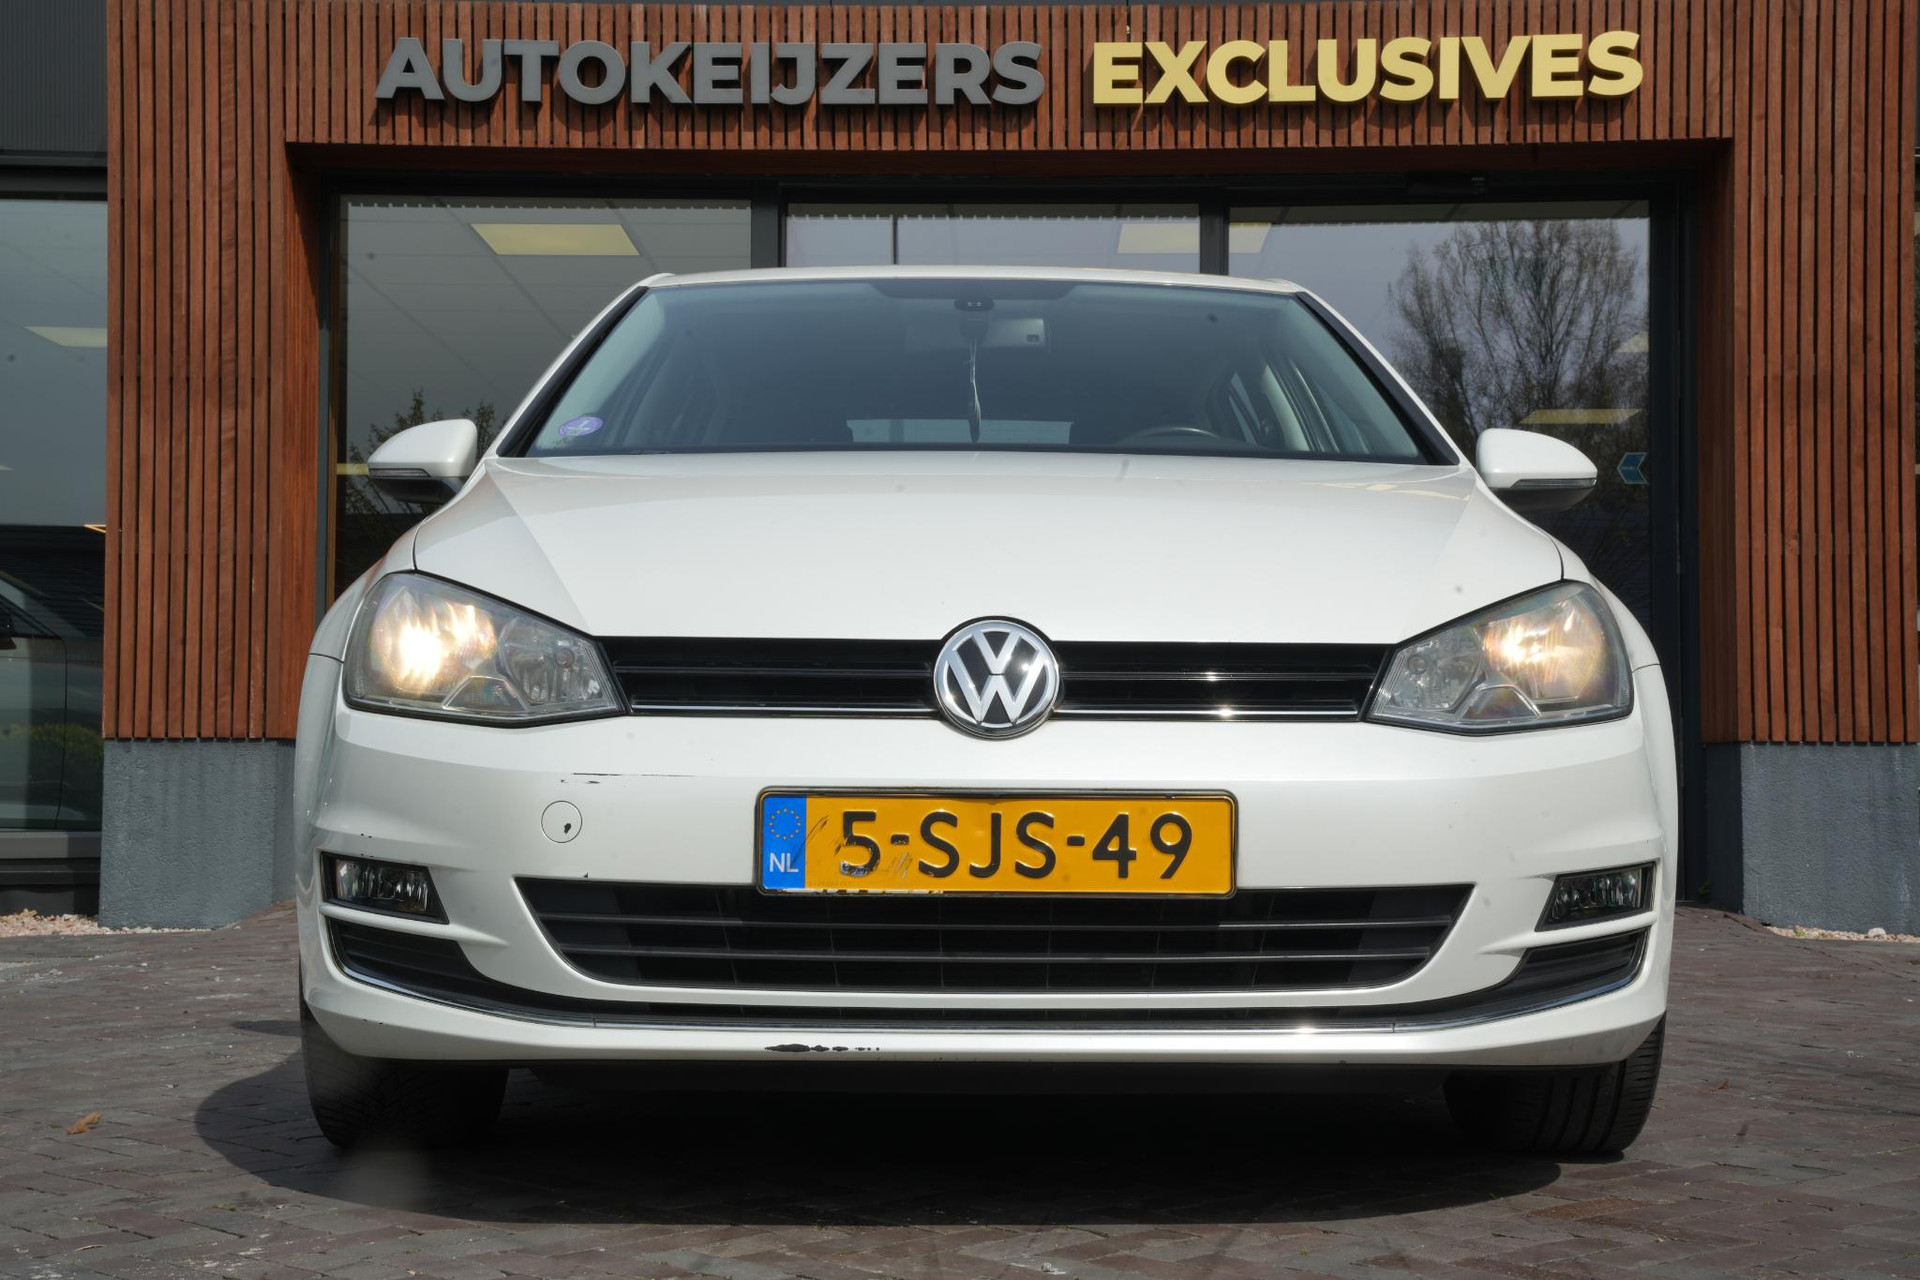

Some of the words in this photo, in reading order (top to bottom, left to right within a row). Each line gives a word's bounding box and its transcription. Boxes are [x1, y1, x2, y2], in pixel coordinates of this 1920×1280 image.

[374, 37, 1046, 106] AUTOKEIJZERS
[1093, 31, 1644, 105] EXCLUSIVES
[769, 853, 799, 873] NL
[840, 808, 1193, 879] 5-SJS-49
